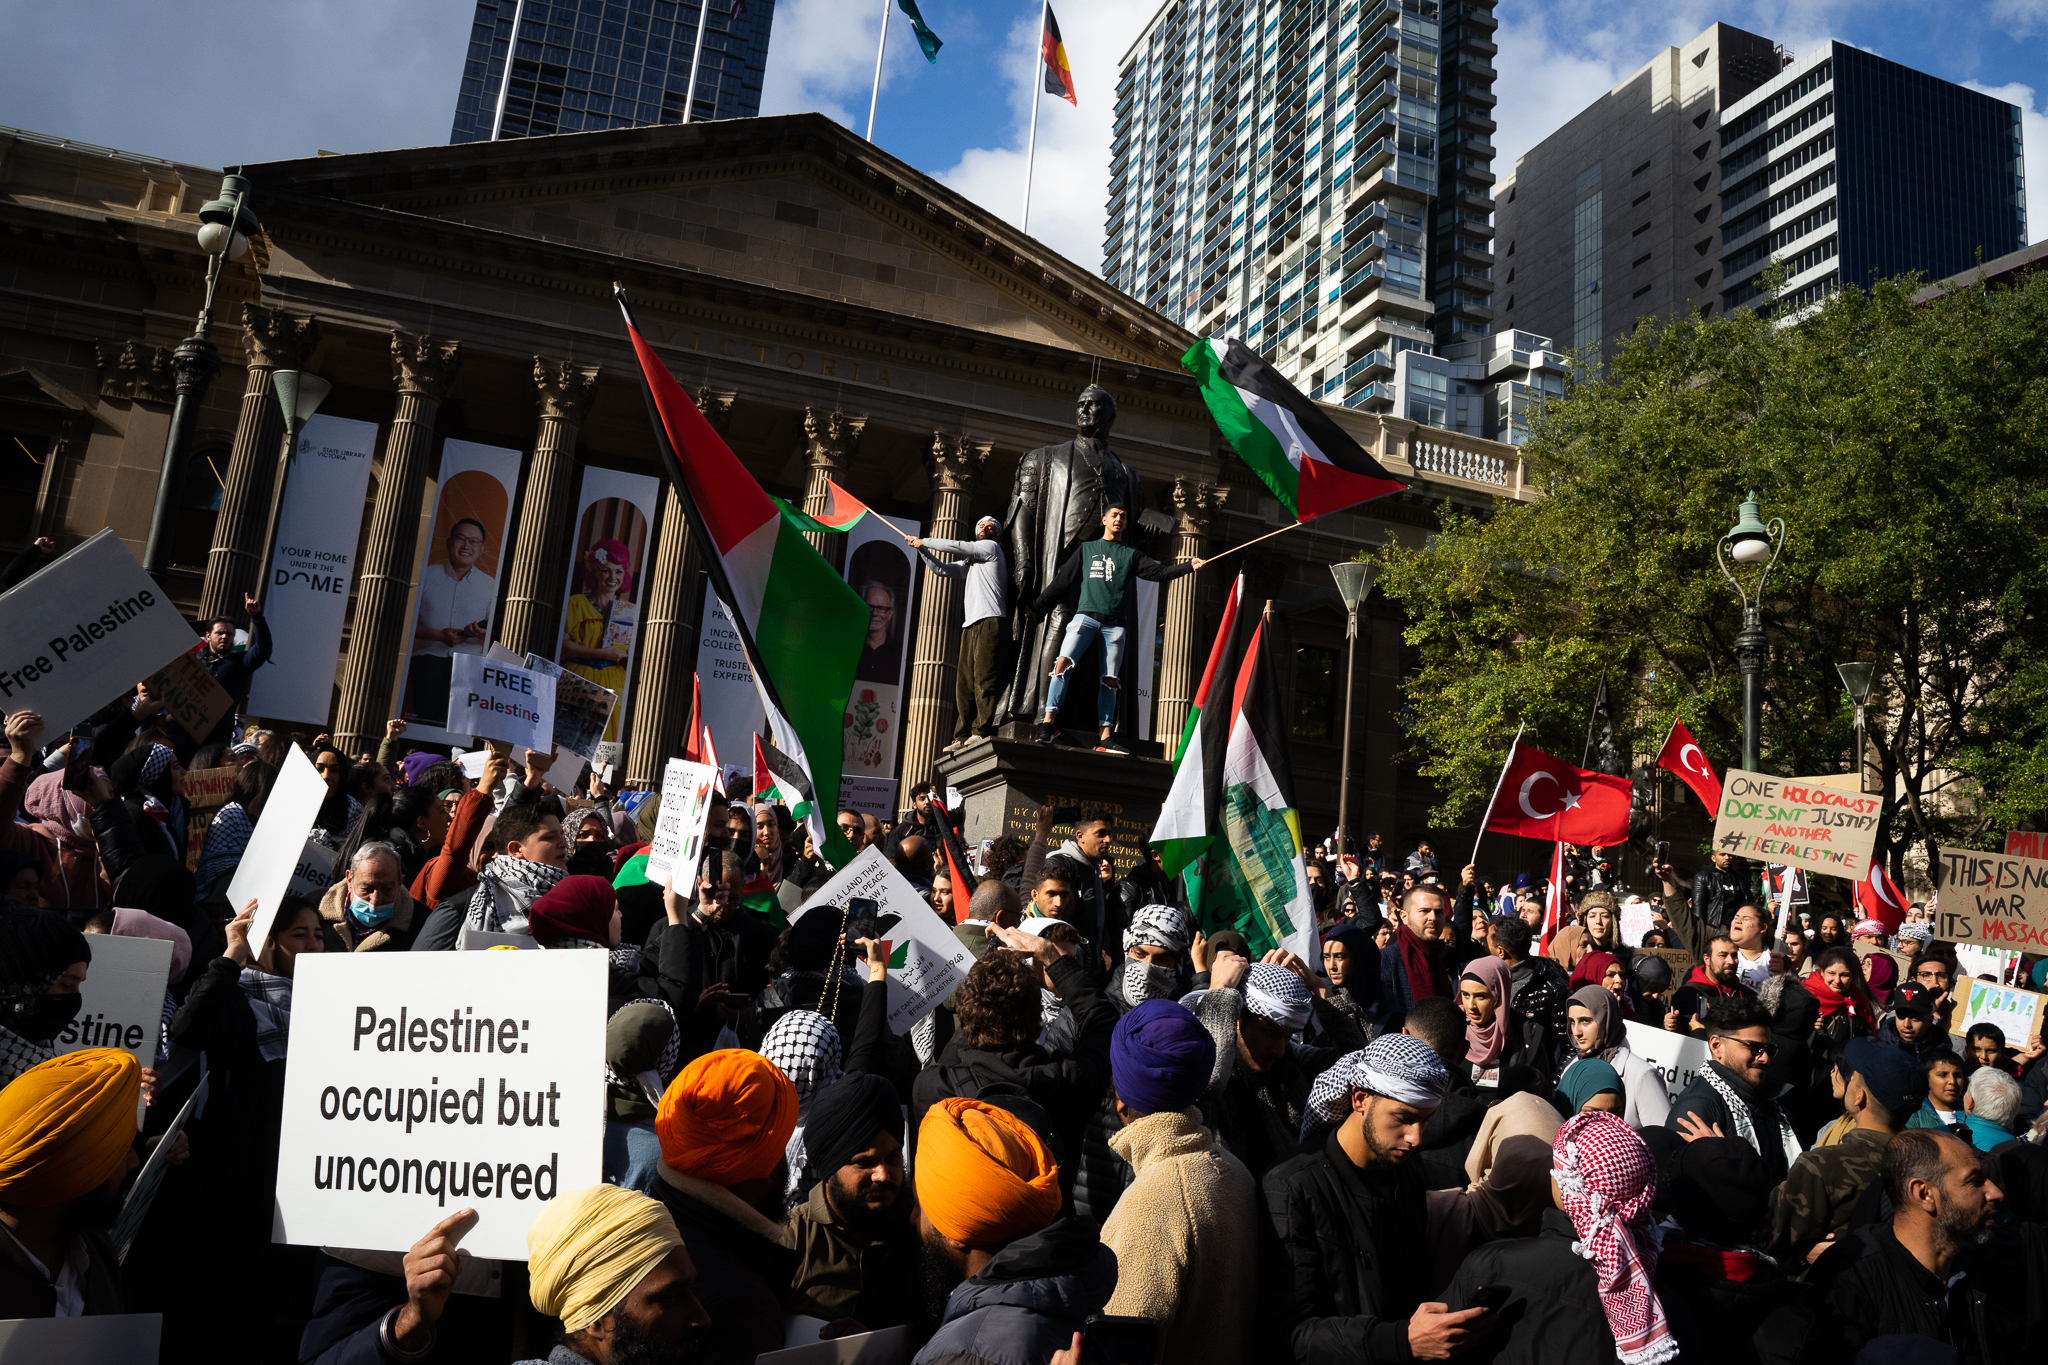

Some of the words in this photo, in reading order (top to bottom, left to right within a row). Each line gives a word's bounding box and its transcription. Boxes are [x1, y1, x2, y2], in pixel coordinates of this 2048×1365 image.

[656, 324, 894, 389] VICTORIA
[317, 452, 347, 461] VICTORIA
[322, 447, 339, 455] STATE
[341, 450, 366, 458] LIBRARY
[281, 546, 311, 558] YOUR
[314, 551, 348, 564] HOME
[290, 560, 318, 570] UNDER
[319, 564, 334, 573] THE
[274, 569, 344, 594] DOME
[0, 655, 53, 697] Free
[48, 589, 155, 663] Palestine
[180, 654, 215, 697] THE
[482, 667, 532, 695] FREE
[713, 670, 753, 682] EXPERTS
[468, 692, 540, 724] Palestine
[852, 785, 889, 793] OCCUPATION
[1730, 777, 1780, 798] ONE
[1782, 785, 1879, 814] HOLOCAUST
[851, 800, 886, 809] PALESTINE
[1014, 807, 1029, 816] BY
[1724, 798, 1809, 822] DOESNT
[1810, 808, 1878, 832] JUSTIFY
[1008, 820, 1022, 829] TO
[1764, 822, 1833, 842] ANOTHER
[843, 877, 863, 896] LAND
[861, 860, 881, 882] THAT
[1942, 853, 1994, 887] THIS
[1995, 861, 2020, 889] IS
[1975, 894, 2026, 920] WAR
[1939, 912, 1973, 938] ITS
[915, 979, 935, 999] BREATH
[907, 999, 926, 1017] #FREE
[60, 1013, 144, 1050] stine
[353, 1005, 531, 1055] Palestine:
[319, 1076, 485, 1134] occupied
[496, 1081, 561, 1127] but
[313, 1151, 559, 1207] unconquered
